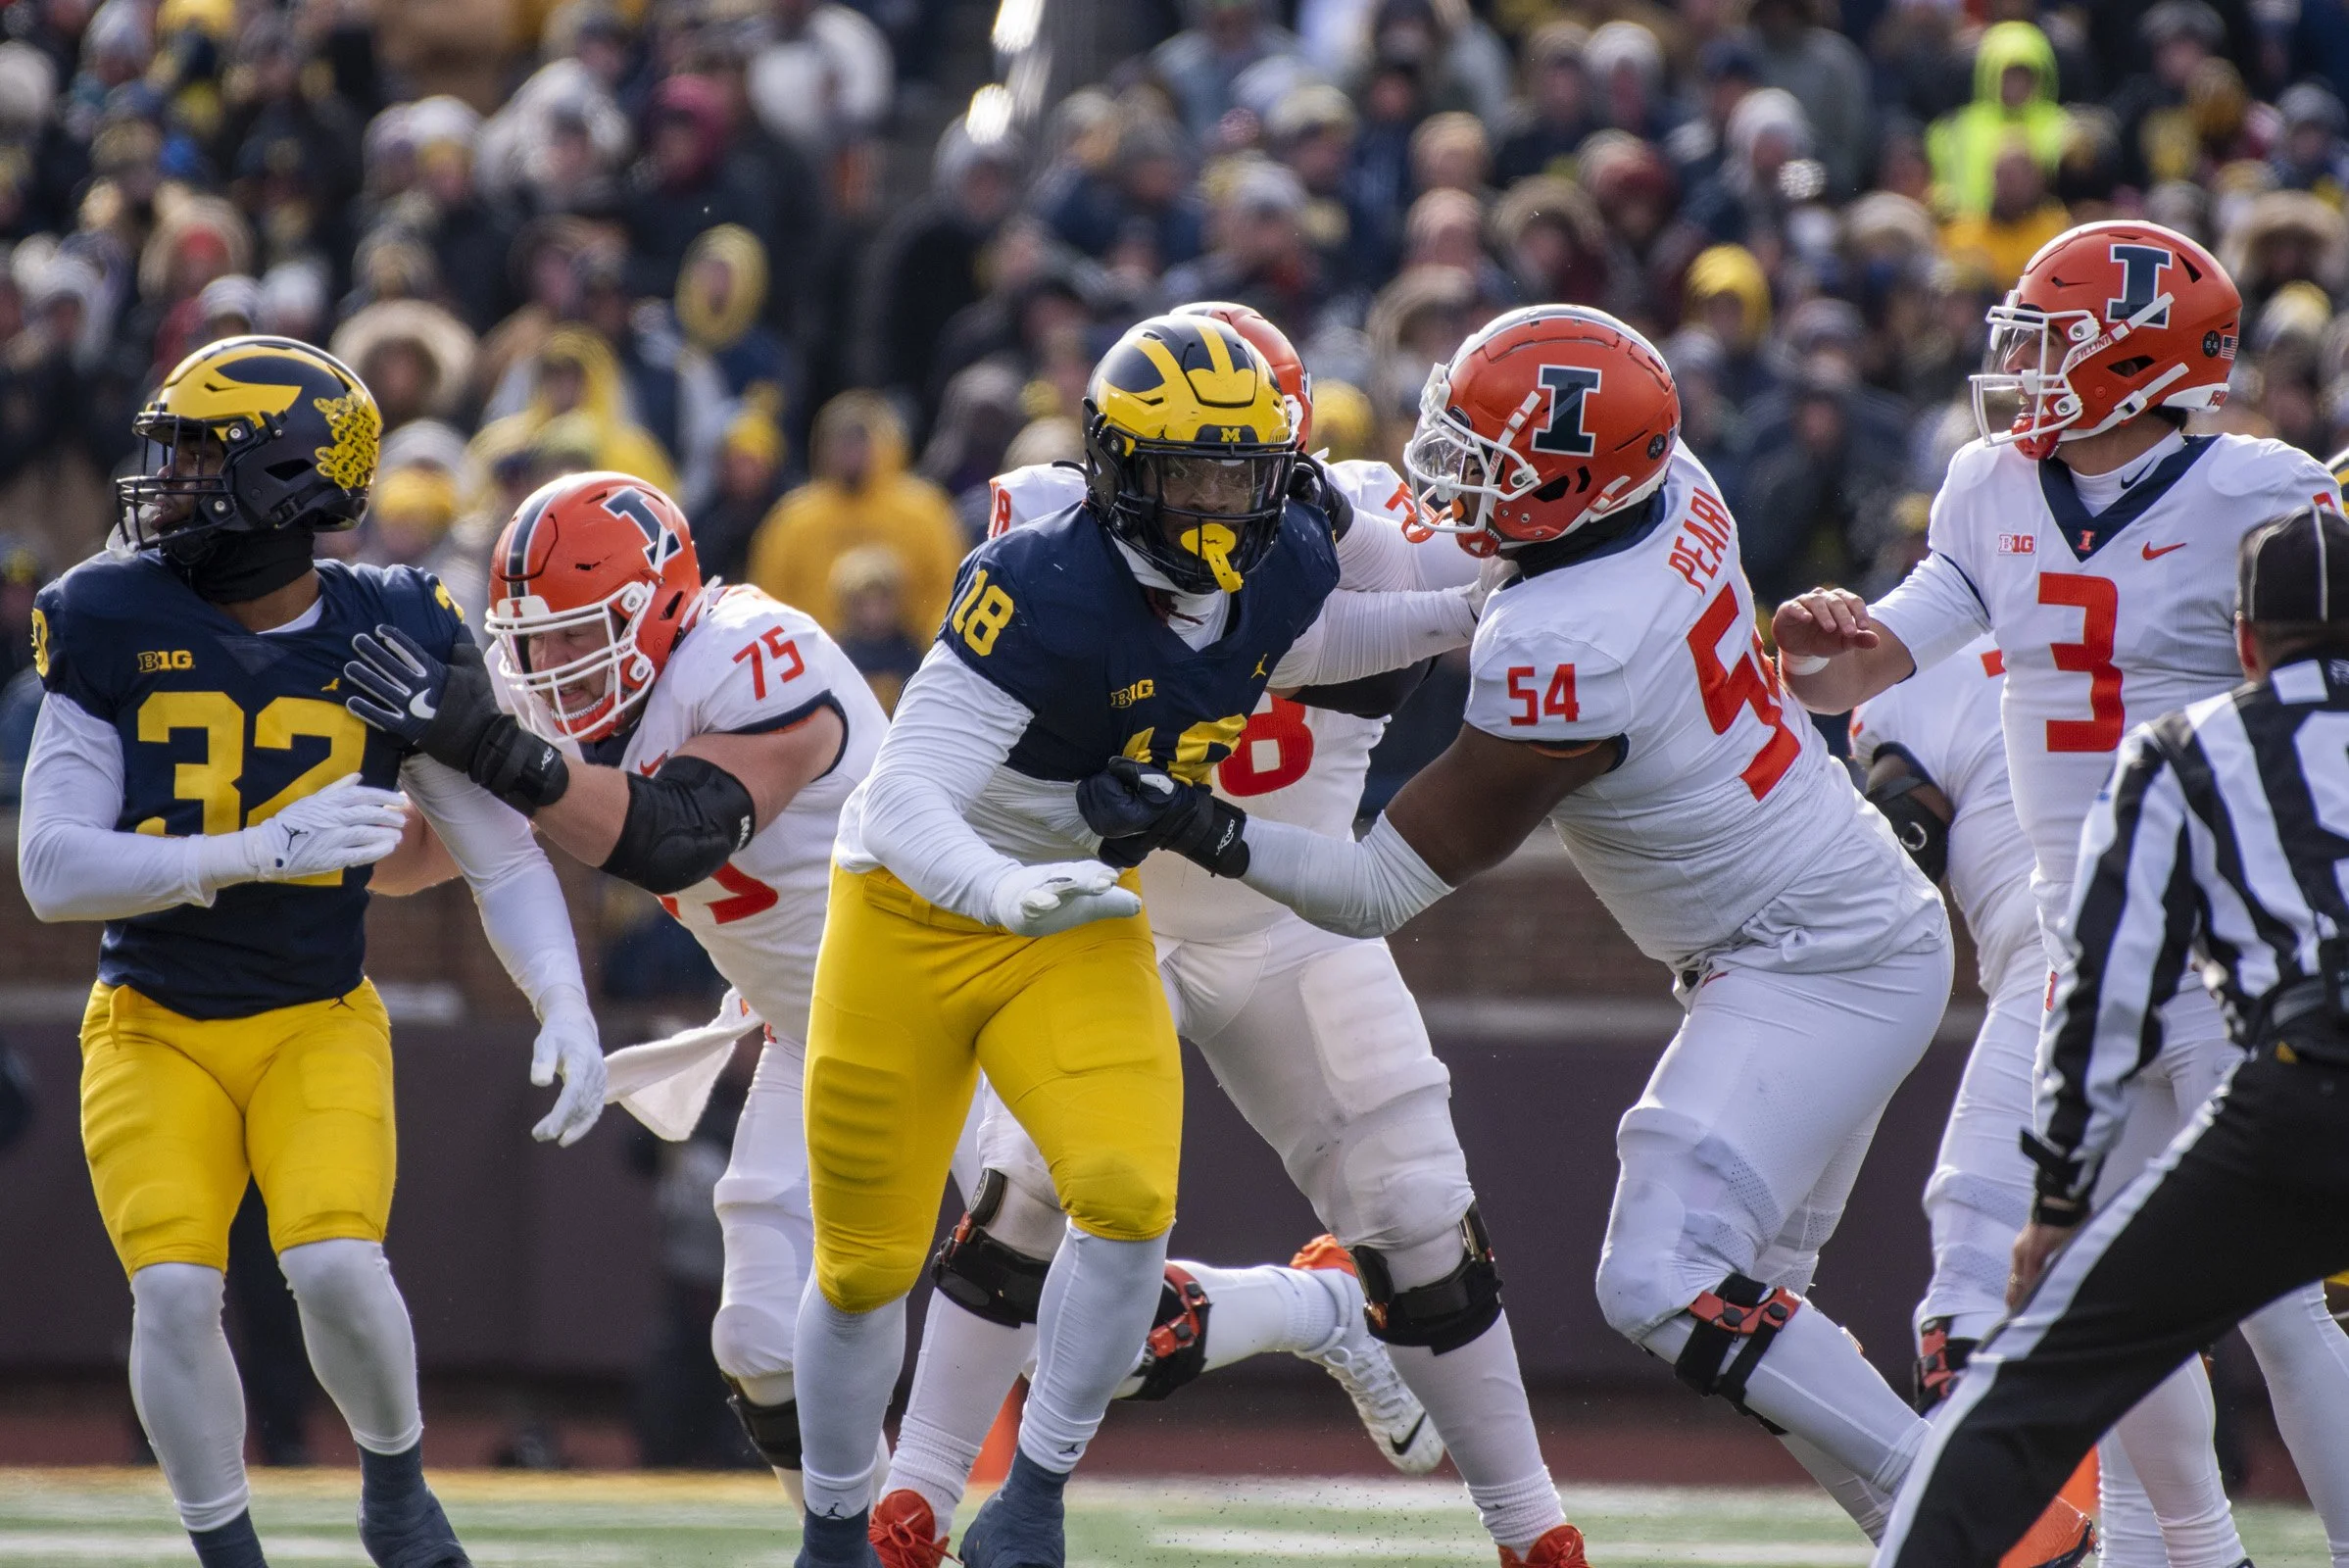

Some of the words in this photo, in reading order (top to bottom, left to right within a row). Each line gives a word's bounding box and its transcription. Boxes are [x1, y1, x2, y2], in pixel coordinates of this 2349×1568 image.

[2105, 243, 2173, 329] I
[1220, 427, 1241, 443] M
[1531, 364, 1601, 457] I
[600, 485, 684, 571] I
[2078, 529, 2095, 551] I
[511, 598, 523, 618] I
[952, 569, 1014, 657] 18
[731, 624, 806, 700] 75
[1507, 662, 1580, 726] 54
[1686, 581, 1801, 803] 5
[2038, 571, 2125, 752] 3
[135, 691, 367, 886] 32
